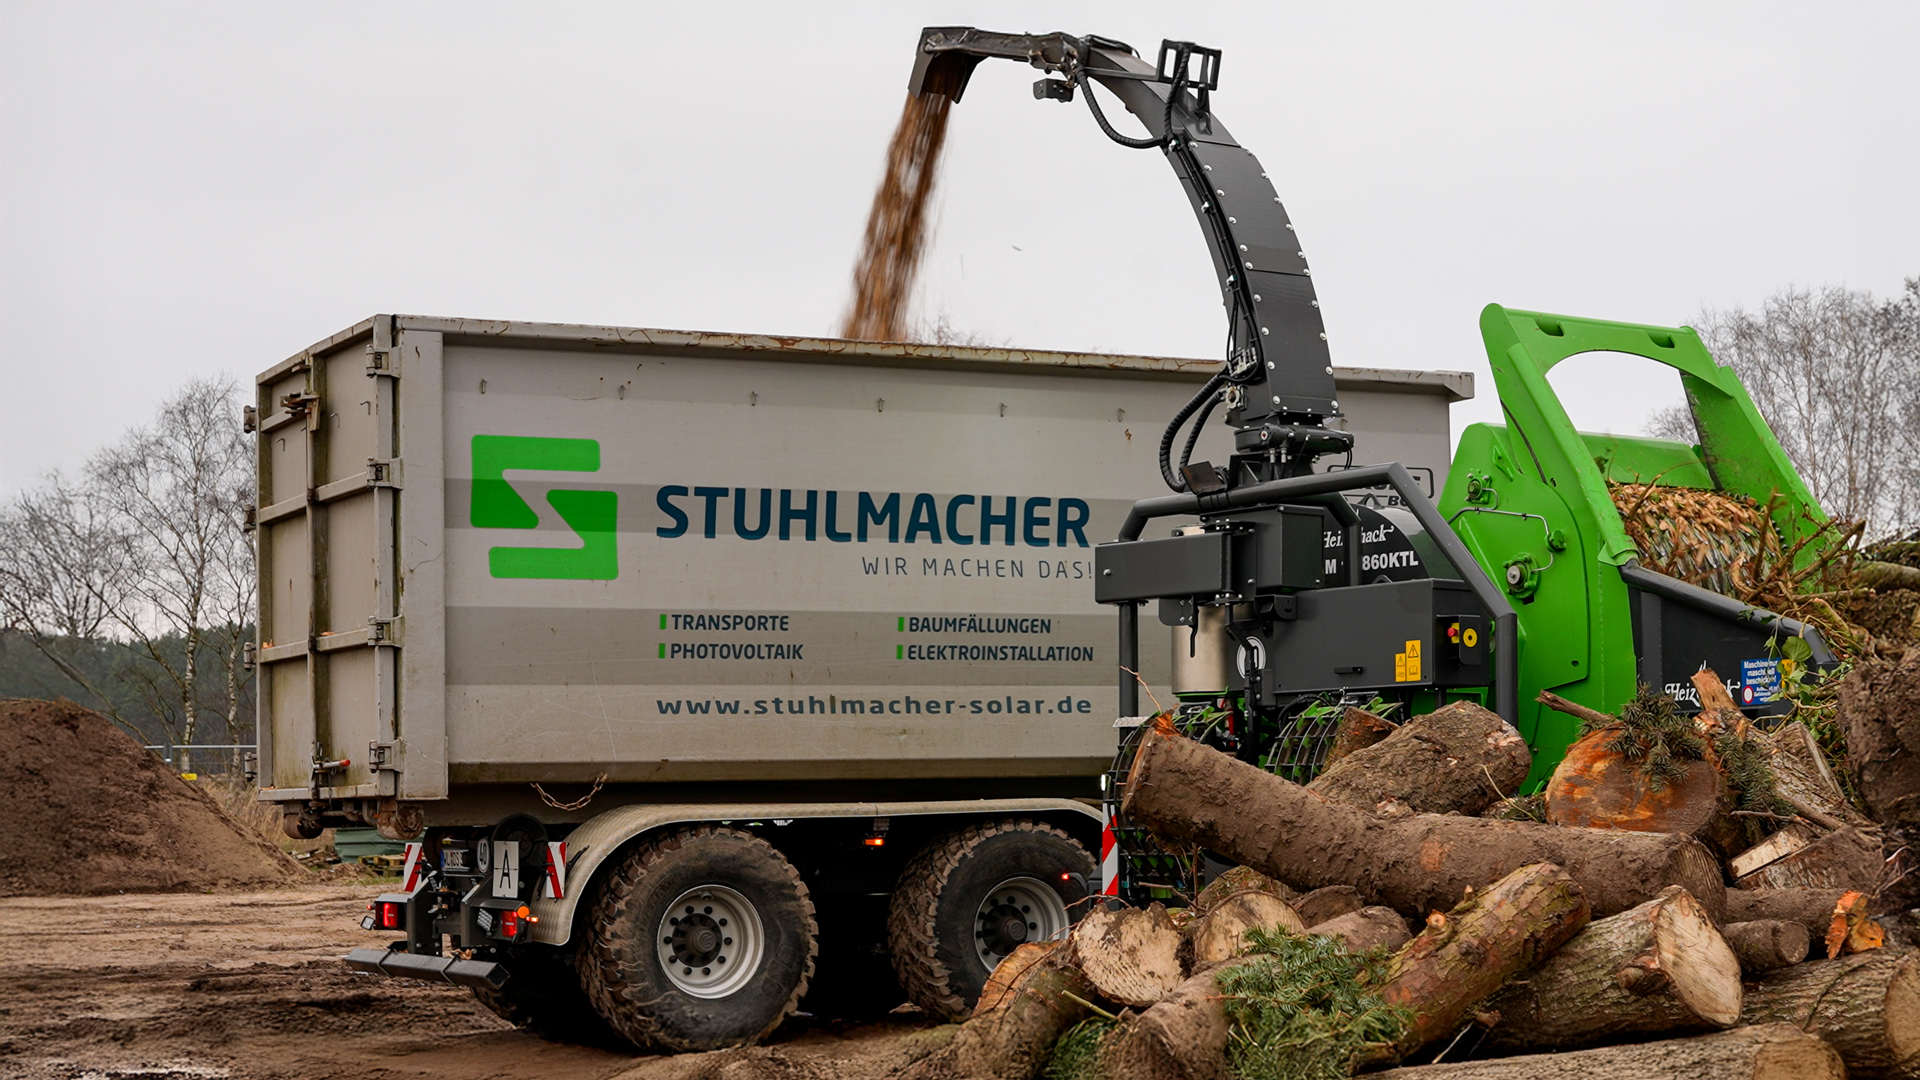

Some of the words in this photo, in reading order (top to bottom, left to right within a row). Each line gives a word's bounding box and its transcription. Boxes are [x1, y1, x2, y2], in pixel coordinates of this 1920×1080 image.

[656, 485, 1091, 548] STUHLMACHER
[862, 557, 908, 576] WIR
[922, 558, 1024, 578] MACHEN
[1038, 561, 1093, 580] DAS!
[671, 614, 789, 632] TRANSPORTE
[908, 614, 1052, 634] BAUMFÄLLUNGEN
[670, 643, 804, 660] PHOTOVOLTAIK
[907, 645, 1095, 662] ELEKTROINSTALLATION
[657, 695, 1093, 715] www.stuhlmacher-solar.de
[499, 849, 511, 889] A
